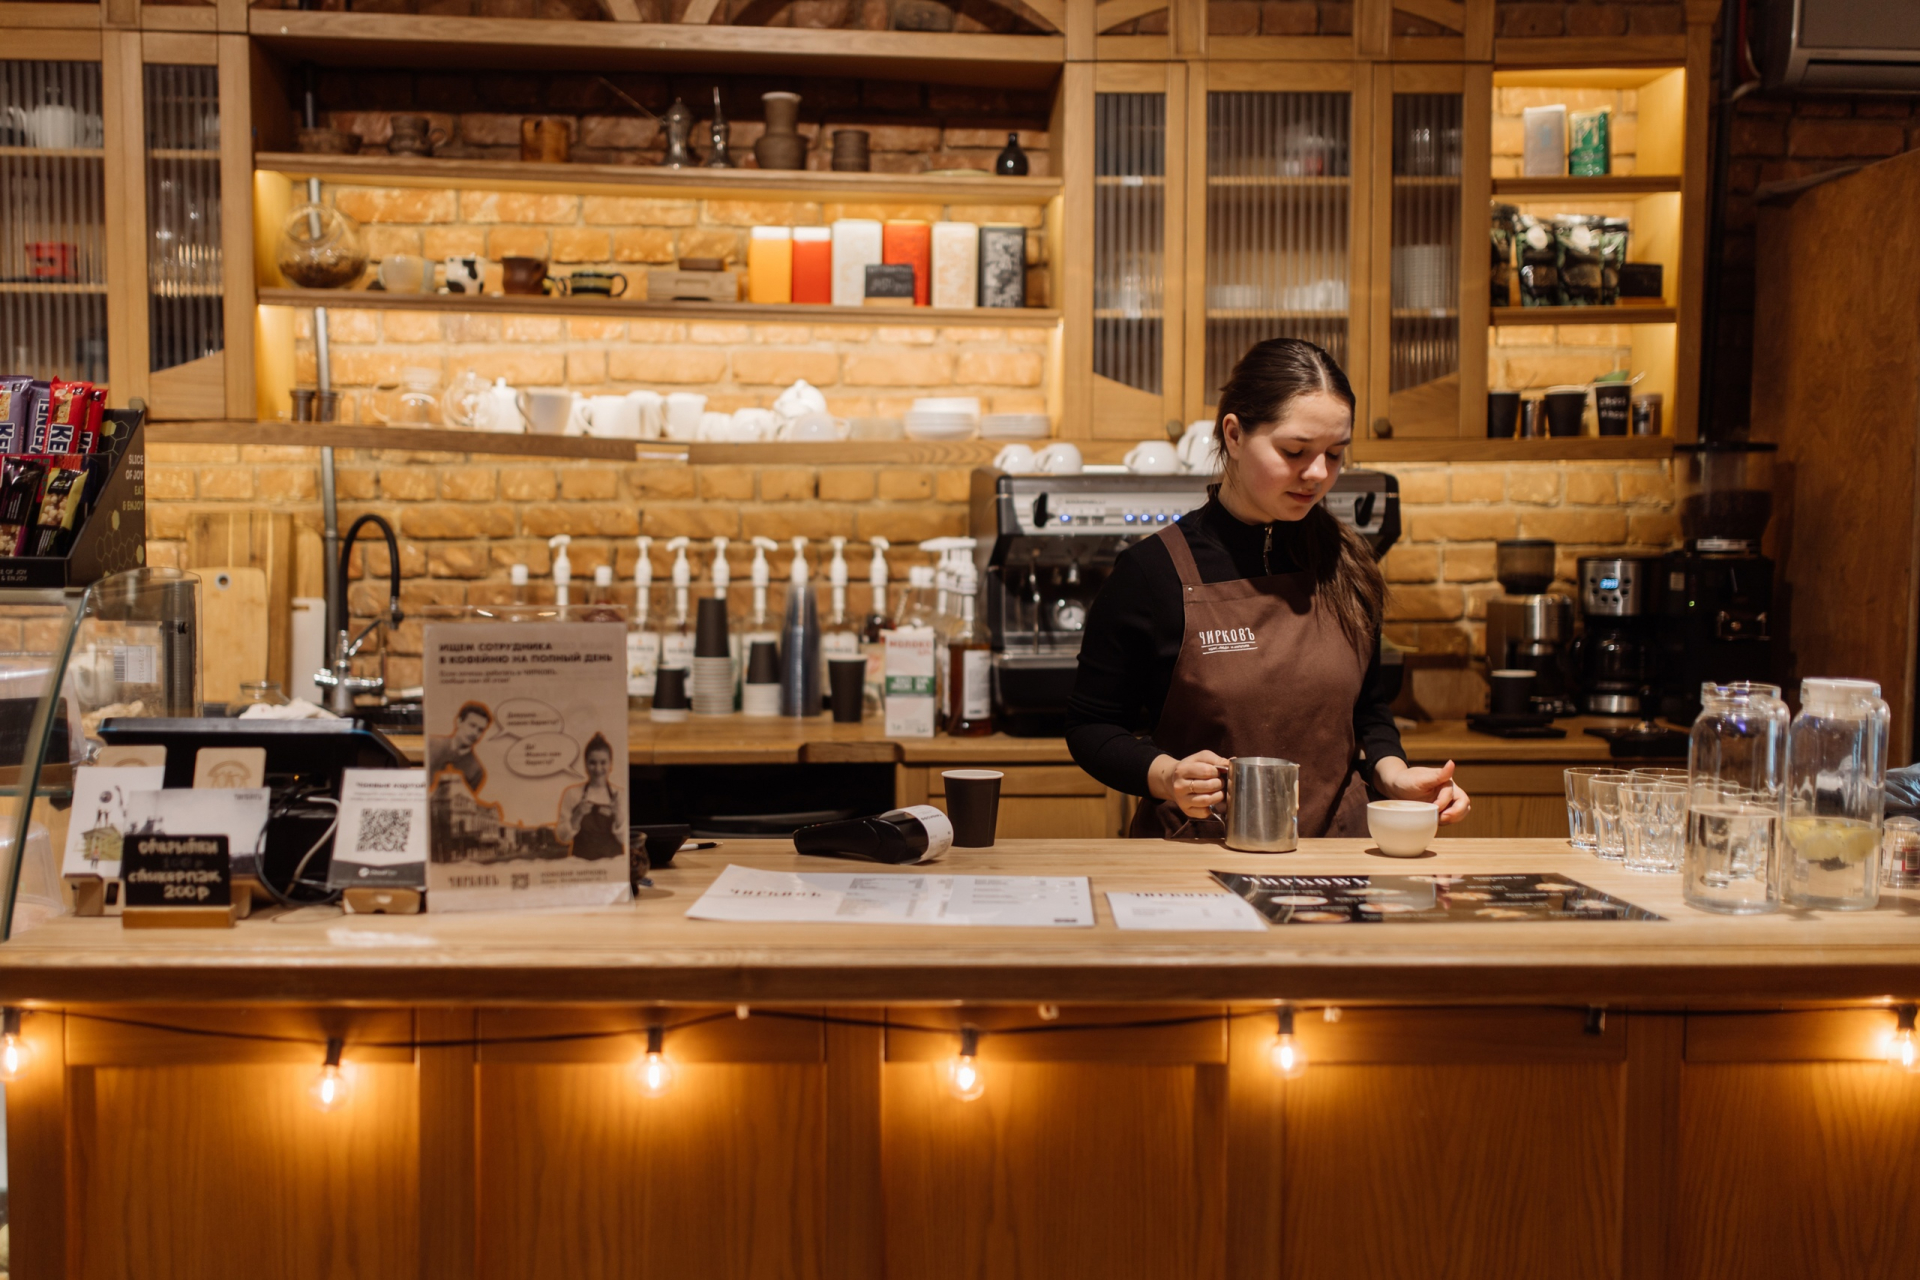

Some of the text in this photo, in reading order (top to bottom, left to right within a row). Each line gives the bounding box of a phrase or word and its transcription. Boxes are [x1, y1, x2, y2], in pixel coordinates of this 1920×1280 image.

[128, 454, 144, 465] SLICE
[126, 470, 144, 480] OF JOY
[134, 485, 144, 496] EAT
[127, 500, 144, 511] ENJOY
[1198, 627, 1256, 644] ЧИРКОВЪ
[438, 642, 553, 652] ИЩЕМ СОТРУДНИКА
[584, 654, 612, 664] ДЕНЬ
[164, 884, 196, 898] 200
